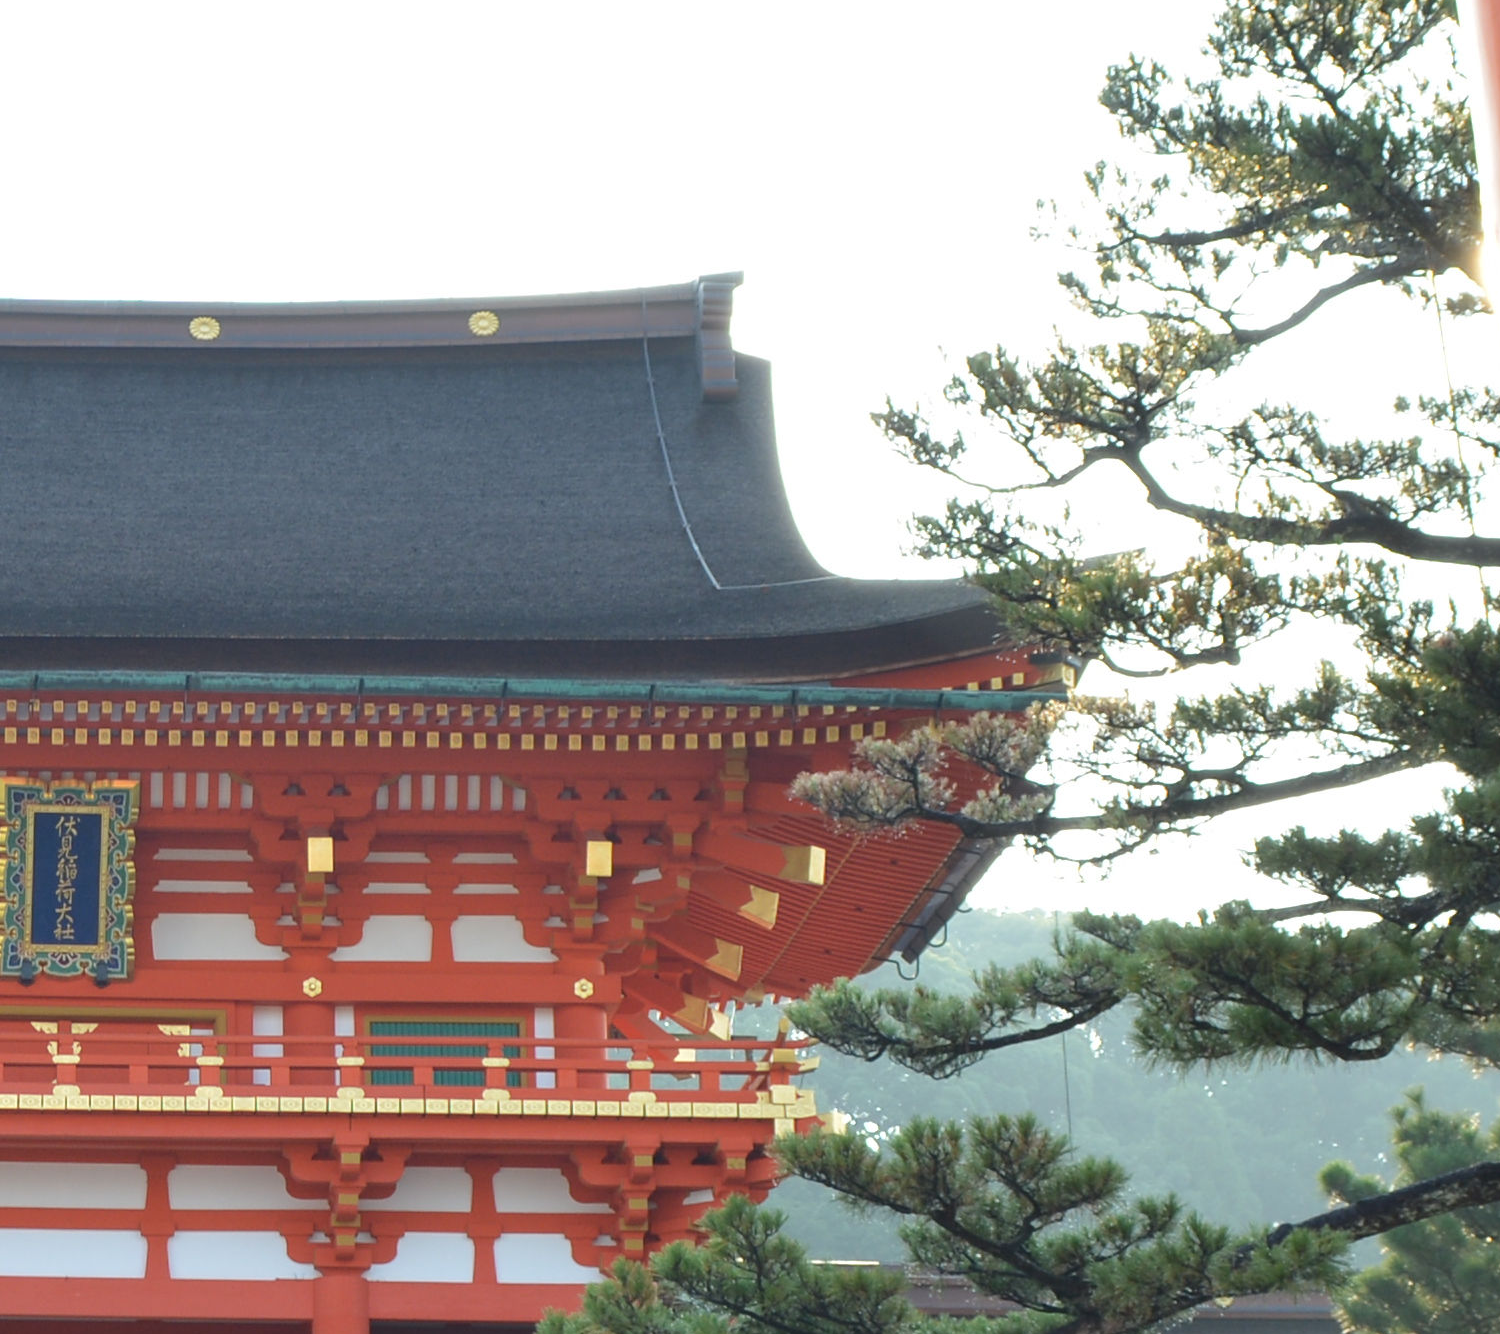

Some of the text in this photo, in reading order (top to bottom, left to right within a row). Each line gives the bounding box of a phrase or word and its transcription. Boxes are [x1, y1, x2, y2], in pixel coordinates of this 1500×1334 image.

[53, 815, 81, 941] 伏見稲荷大社
